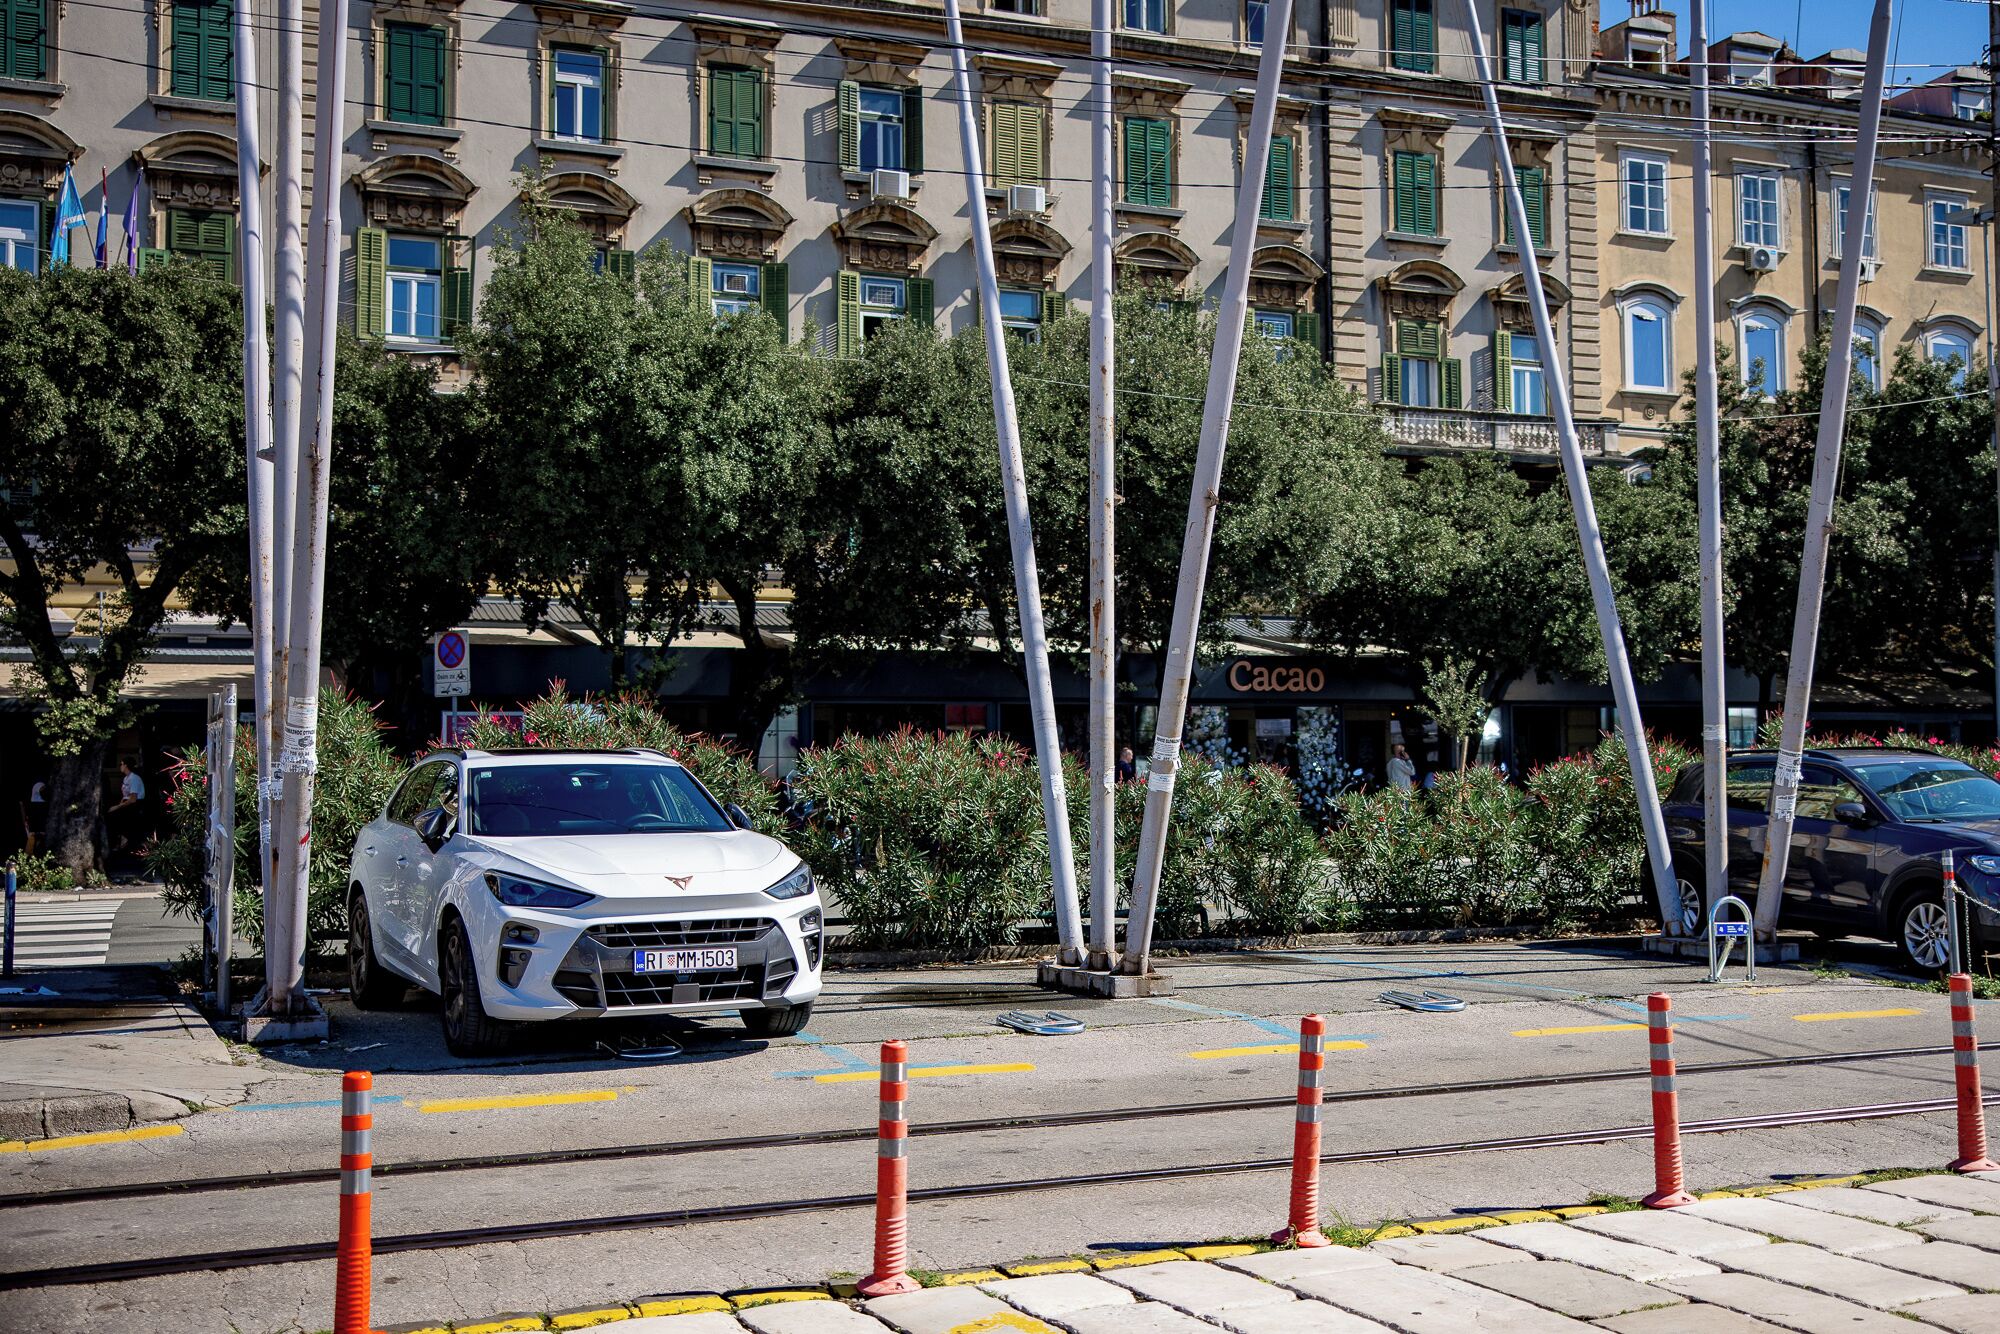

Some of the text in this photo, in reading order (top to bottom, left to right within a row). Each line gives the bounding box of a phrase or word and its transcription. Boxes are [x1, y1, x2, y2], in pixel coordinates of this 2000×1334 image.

[1230, 660, 1325, 692] Cacao
[646, 949, 734, 969] RI MM-1503
